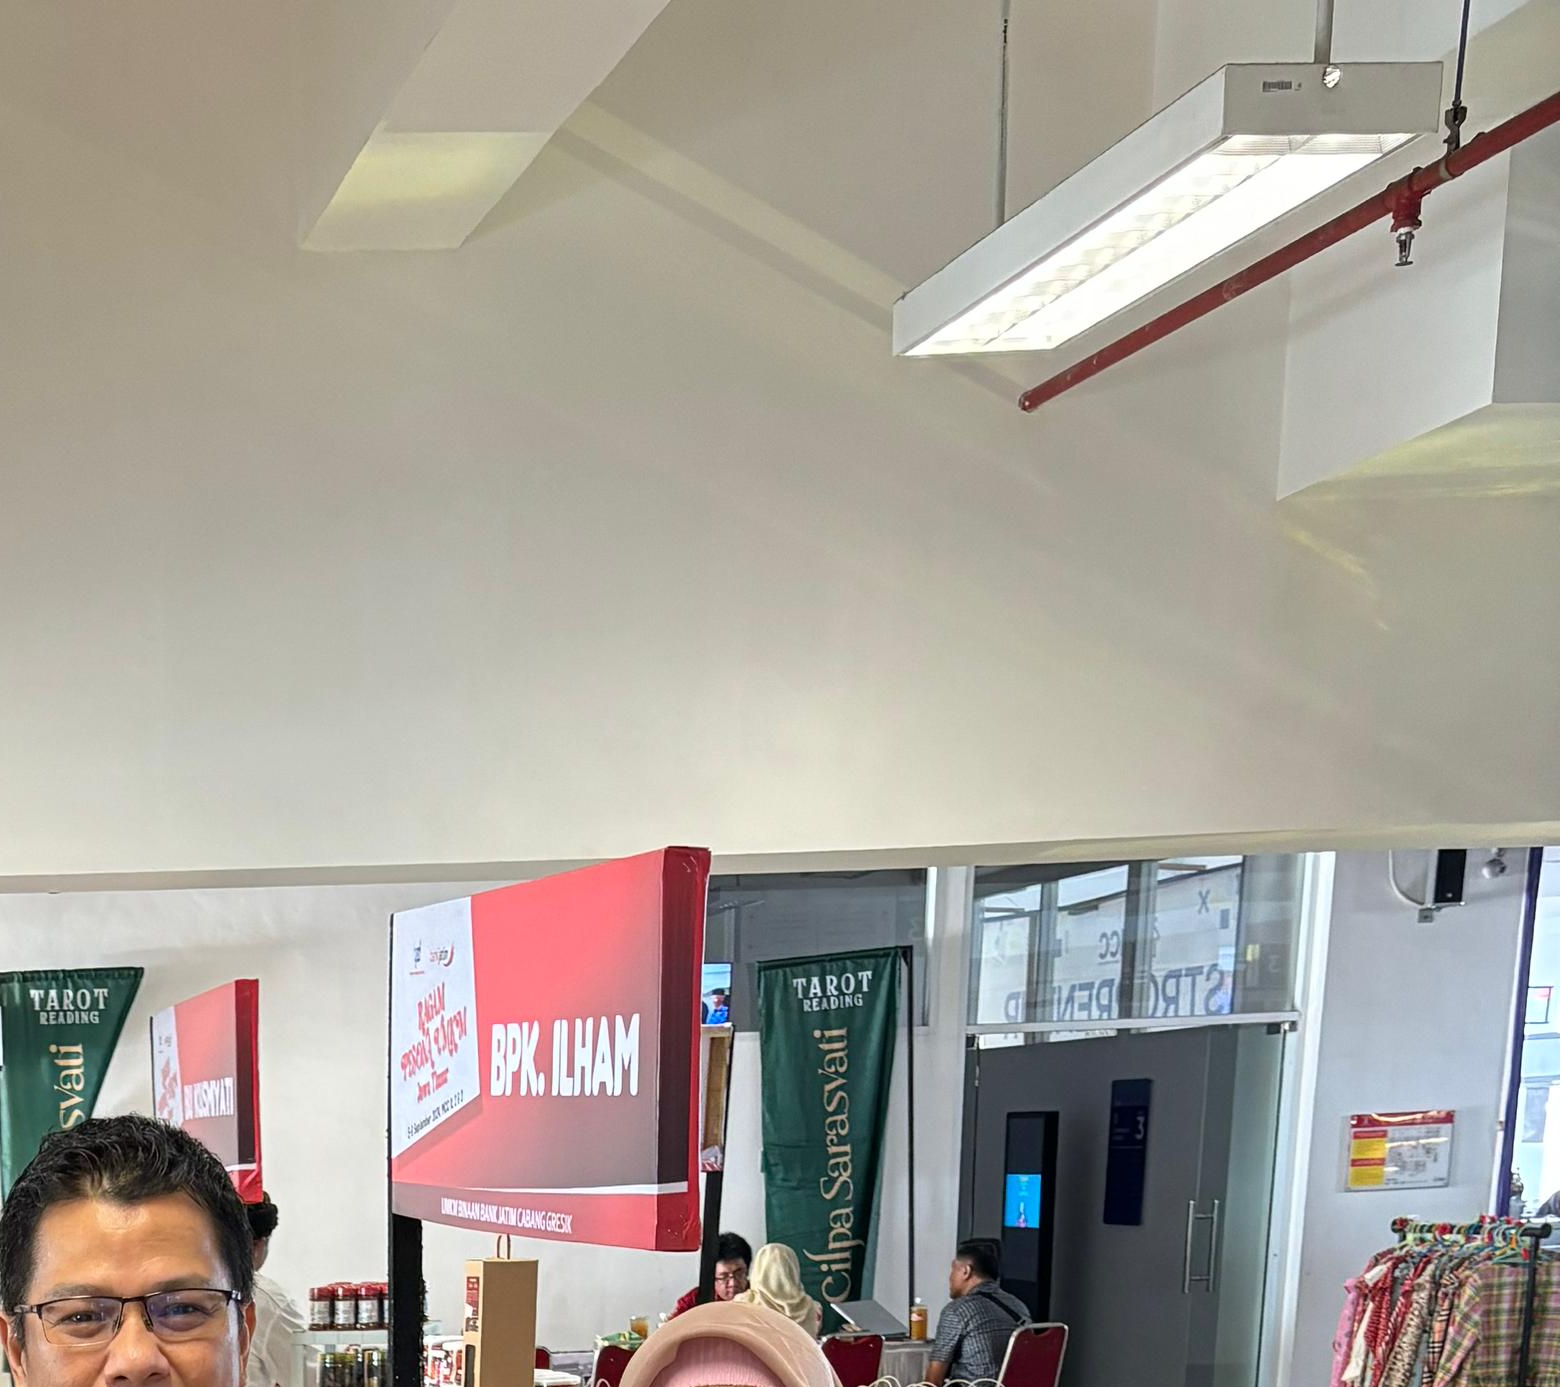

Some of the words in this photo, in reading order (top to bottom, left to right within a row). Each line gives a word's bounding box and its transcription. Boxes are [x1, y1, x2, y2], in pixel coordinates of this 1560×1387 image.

[792, 970, 872, 999] TAROT
[30, 988, 109, 1011] TAROT
[417, 982, 446, 1036] RAGAM
[803, 993, 864, 1012] READING
[40, 1011, 100, 1025] READING
[490, 1020, 545, 1097] BPK.
[551, 1013, 640, 1097] ILHAM
[49, 1043, 85, 1132] svati
[813, 1026, 854, 1200] Sarasvati
[517, 1208, 546, 1231] CABANG
[546, 1212, 572, 1235] GRESIK
